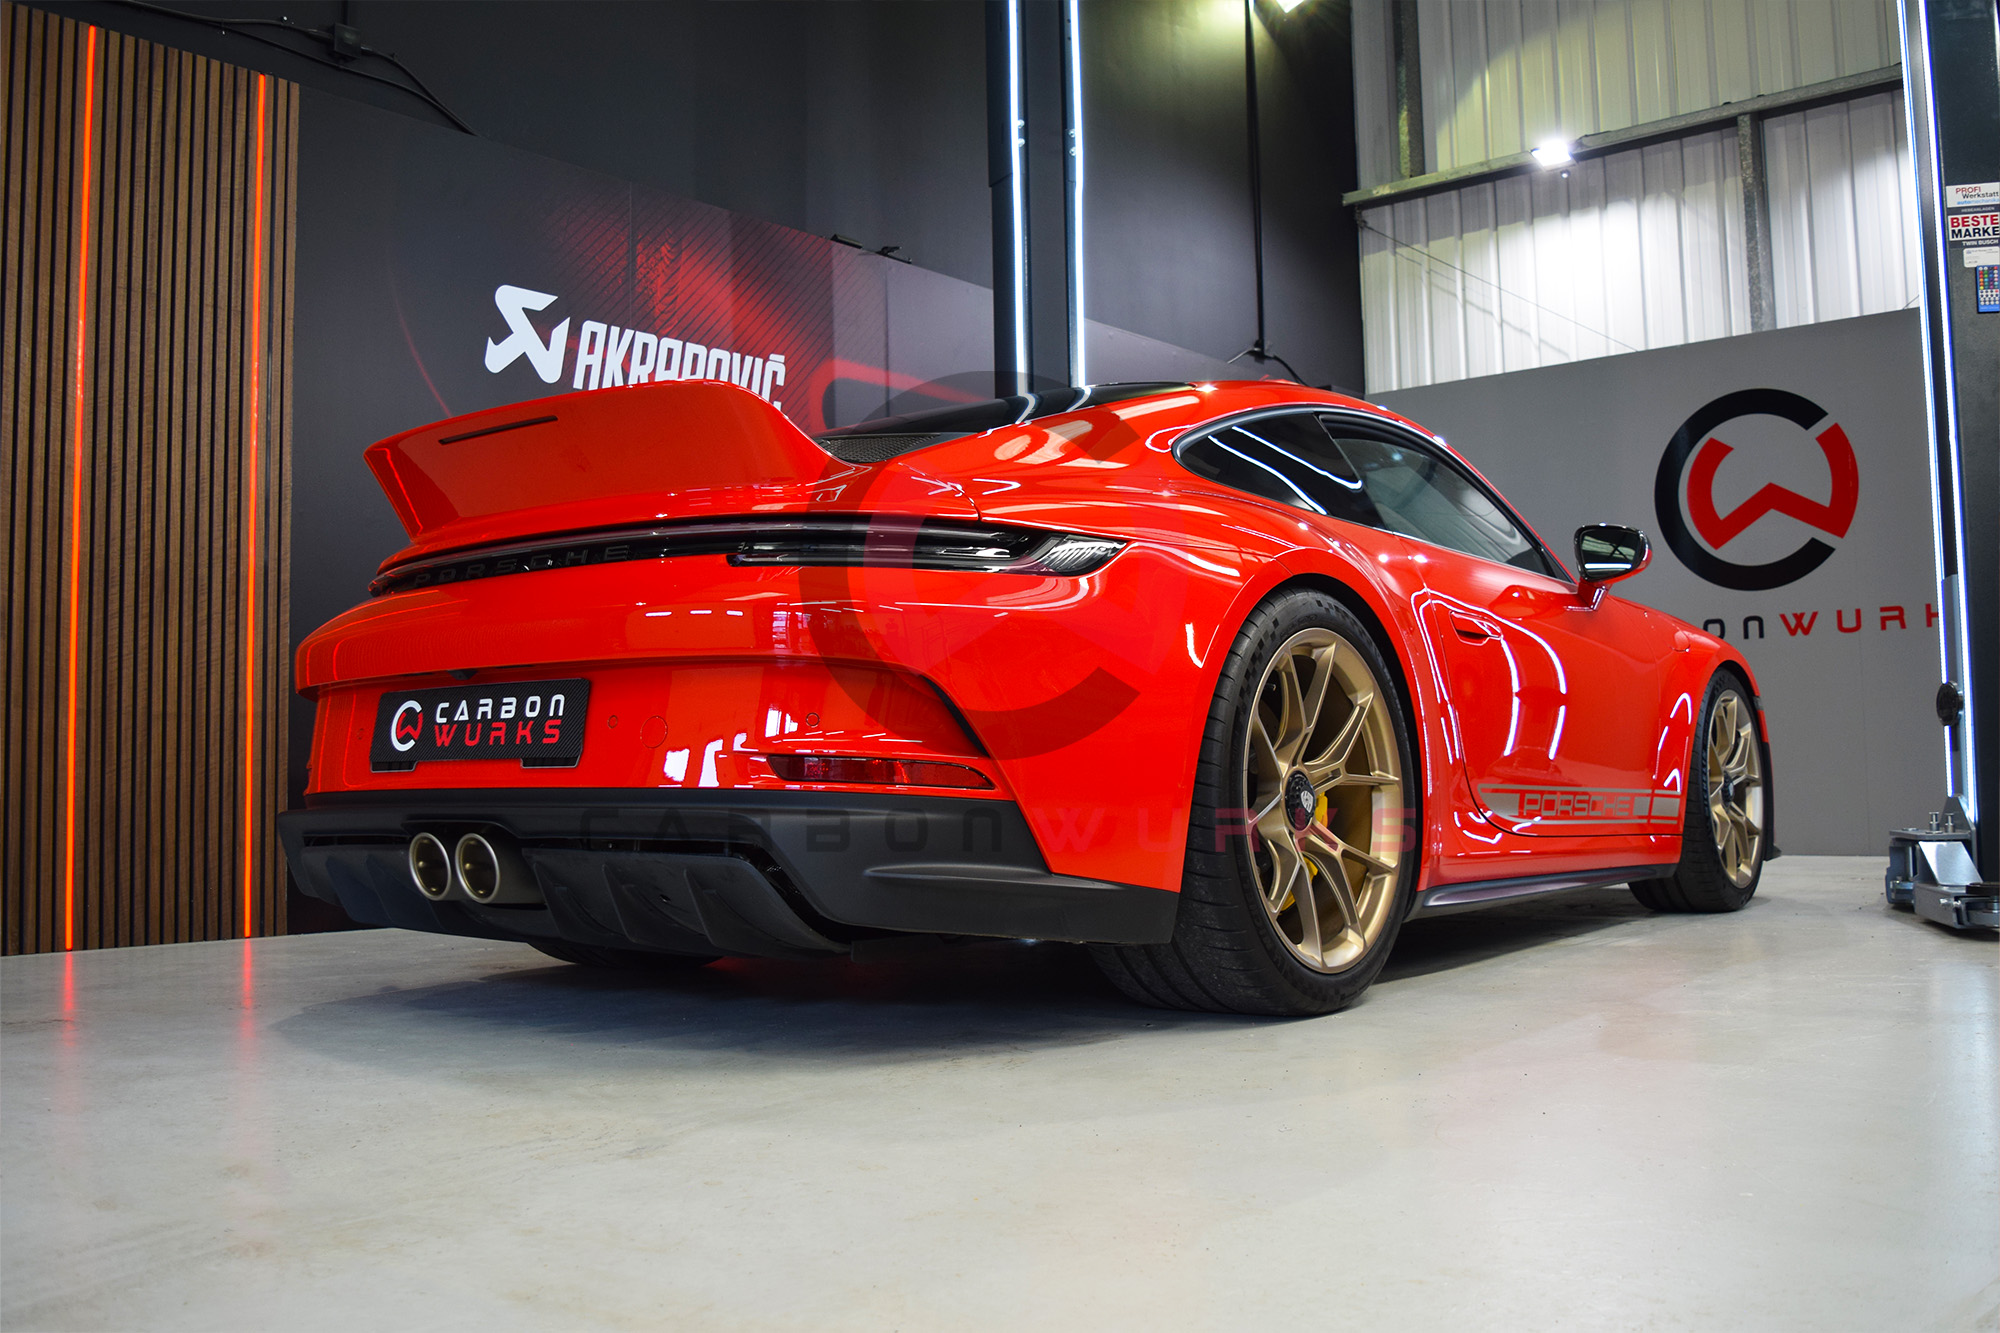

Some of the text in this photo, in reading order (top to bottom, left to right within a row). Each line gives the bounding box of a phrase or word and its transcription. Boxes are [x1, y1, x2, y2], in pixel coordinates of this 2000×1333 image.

[1955, 186, 1982, 195] PROFI
[1962, 191, 1999, 199] Werkstatt
[1950, 214, 1999, 228] BESTE
[1951, 226, 2000, 239] MARKE
[414, 544, 631, 587] PORSCHE
[436, 694, 565, 724] CARBON
[434, 719, 562, 748] WURKS
[1523, 793, 1631, 816] PORSCHE
